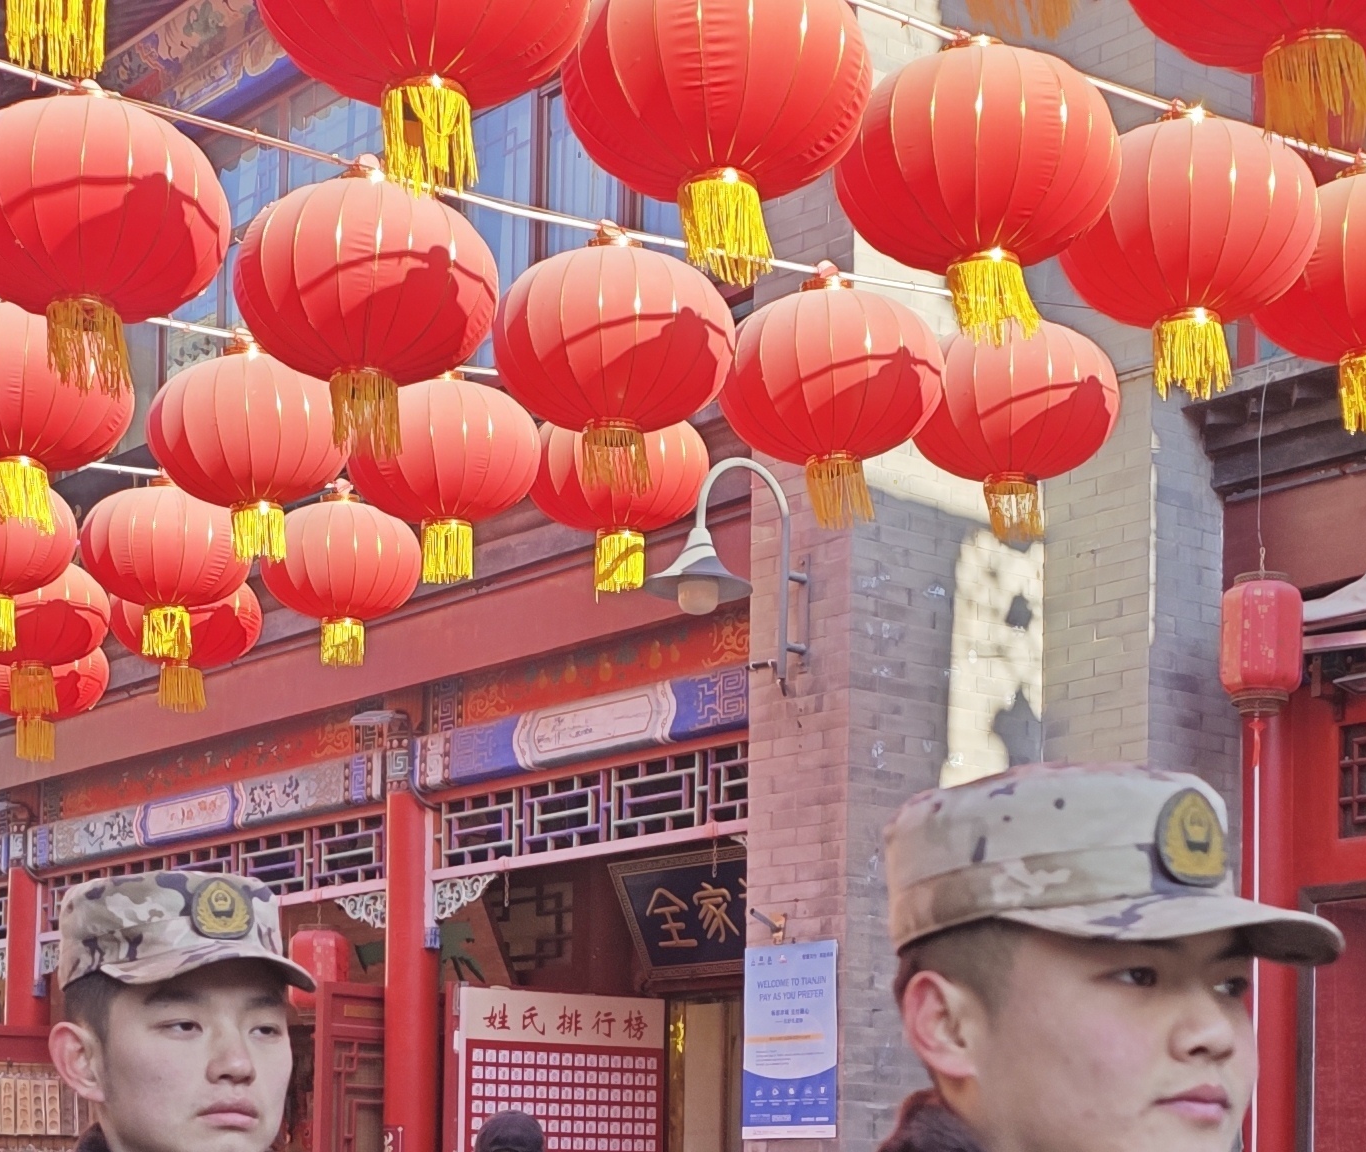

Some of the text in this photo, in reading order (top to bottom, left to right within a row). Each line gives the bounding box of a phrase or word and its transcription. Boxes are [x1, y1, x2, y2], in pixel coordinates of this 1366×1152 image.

[645, 878, 747, 948] 全家
[757, 976, 826, 989] WELCOME TO TIANJIN
[759, 989, 824, 1001] PAY AS YOU PREFER
[483, 1003, 648, 1041] 姓氏排行榜
